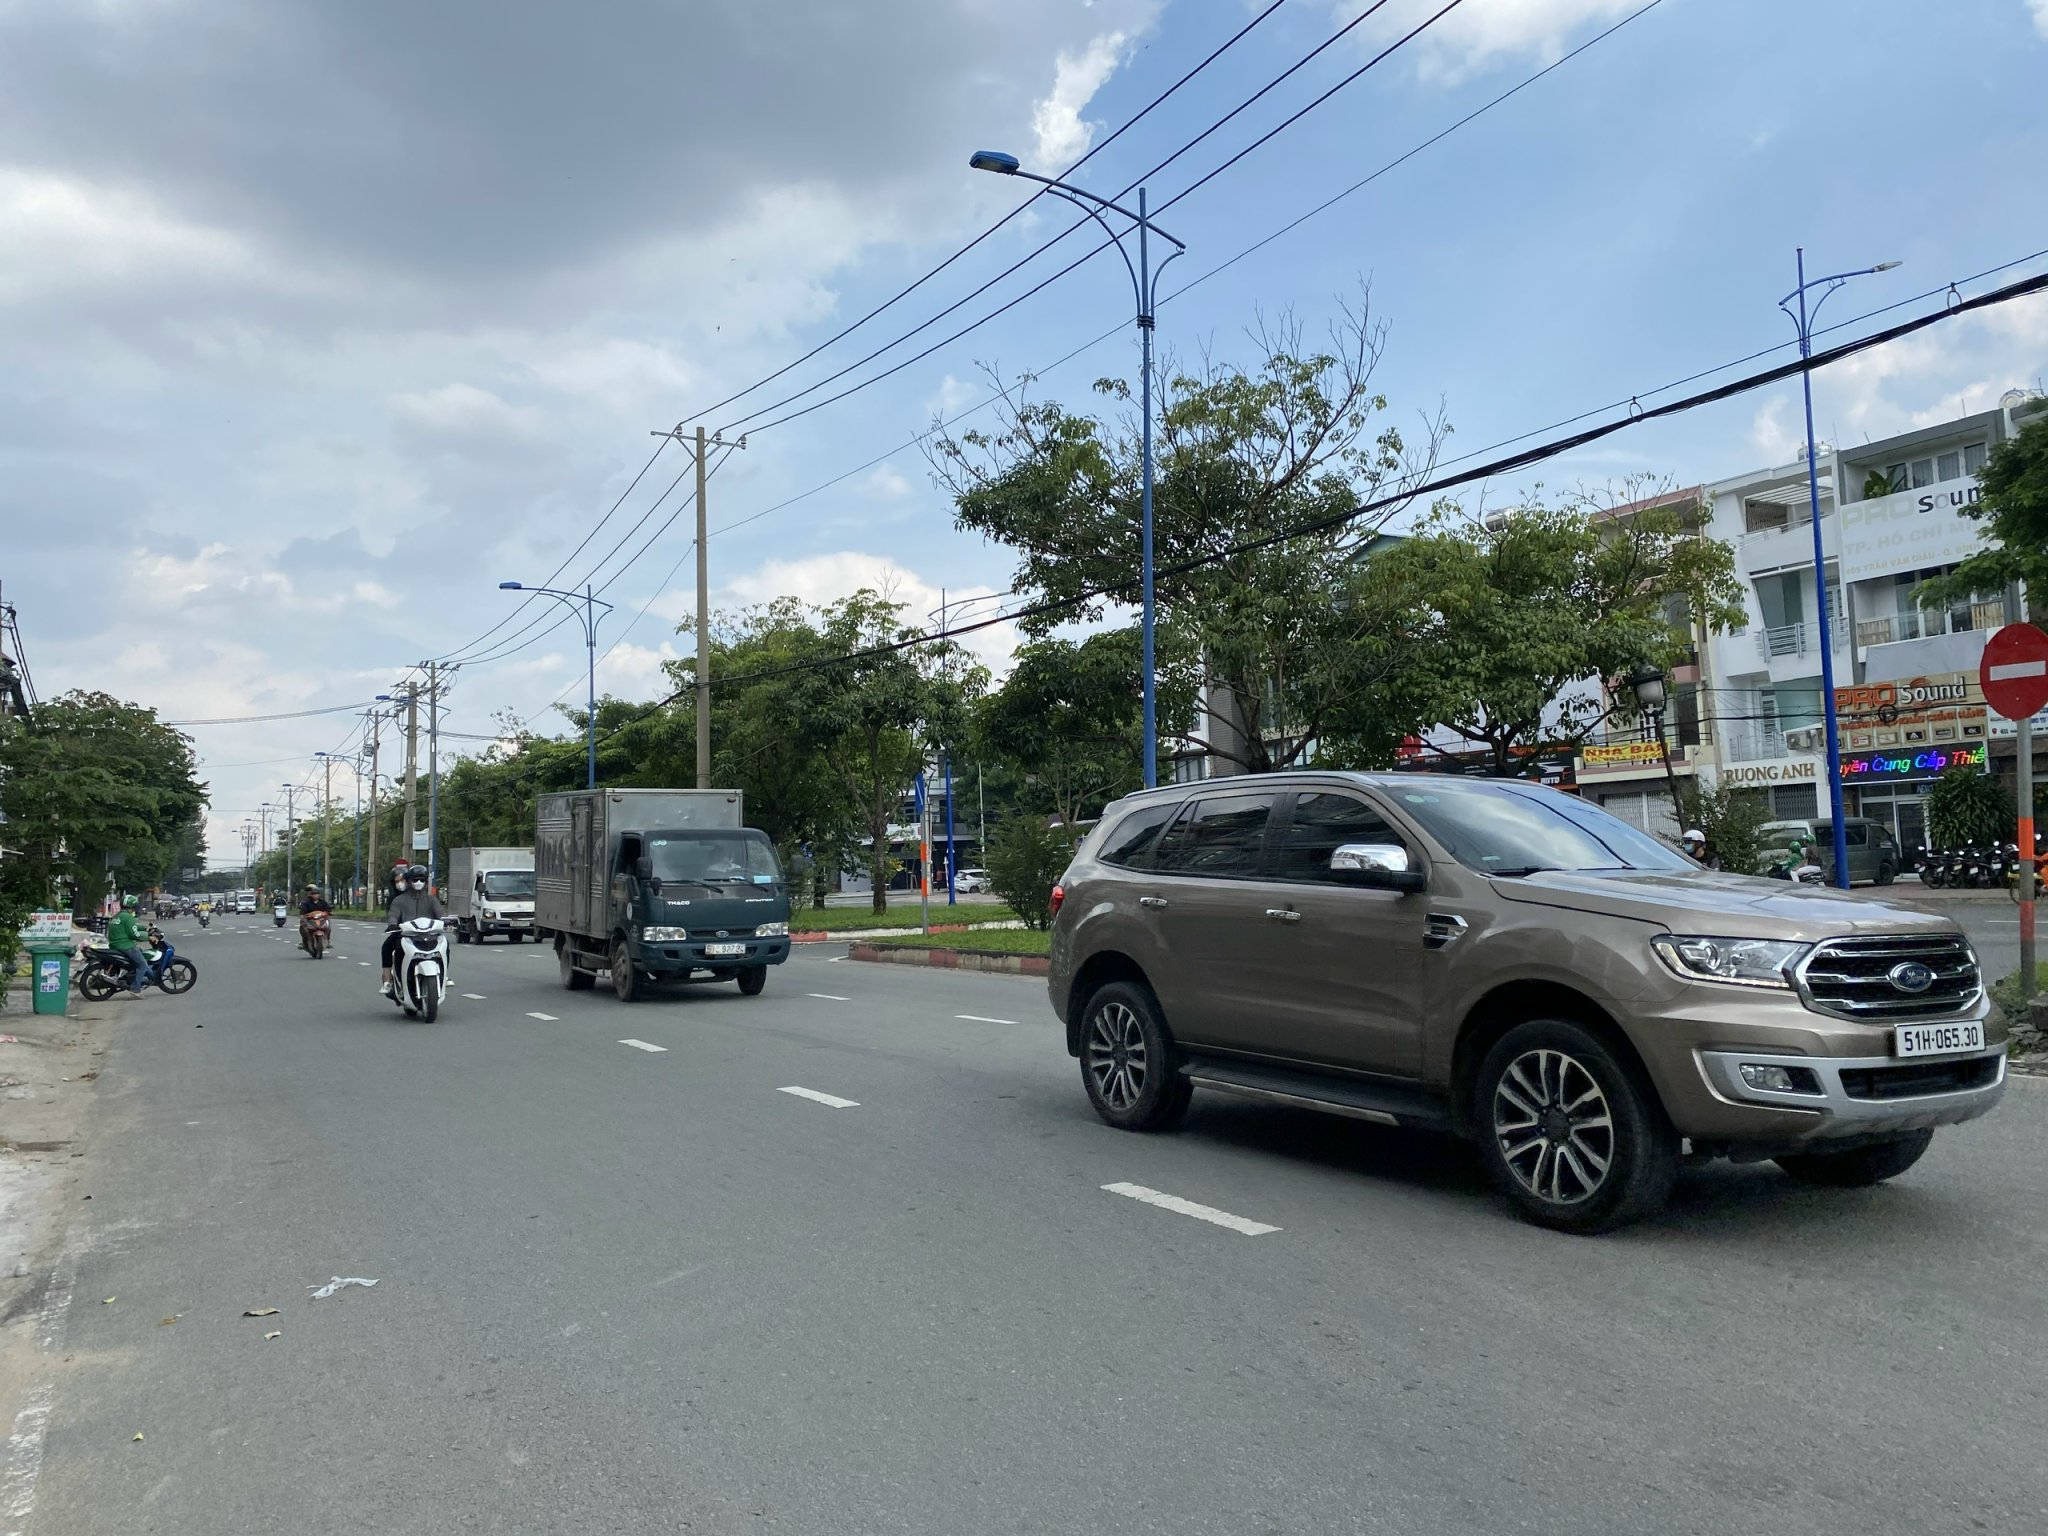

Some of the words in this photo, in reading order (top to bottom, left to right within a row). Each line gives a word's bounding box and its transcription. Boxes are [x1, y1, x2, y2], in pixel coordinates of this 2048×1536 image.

[1842, 494, 1914, 530] PRO
[1834, 683, 1896, 712] PRO
[1782, 762, 1816, 779] ANH
[1904, 1026, 1979, 1052] 51H-065.30
